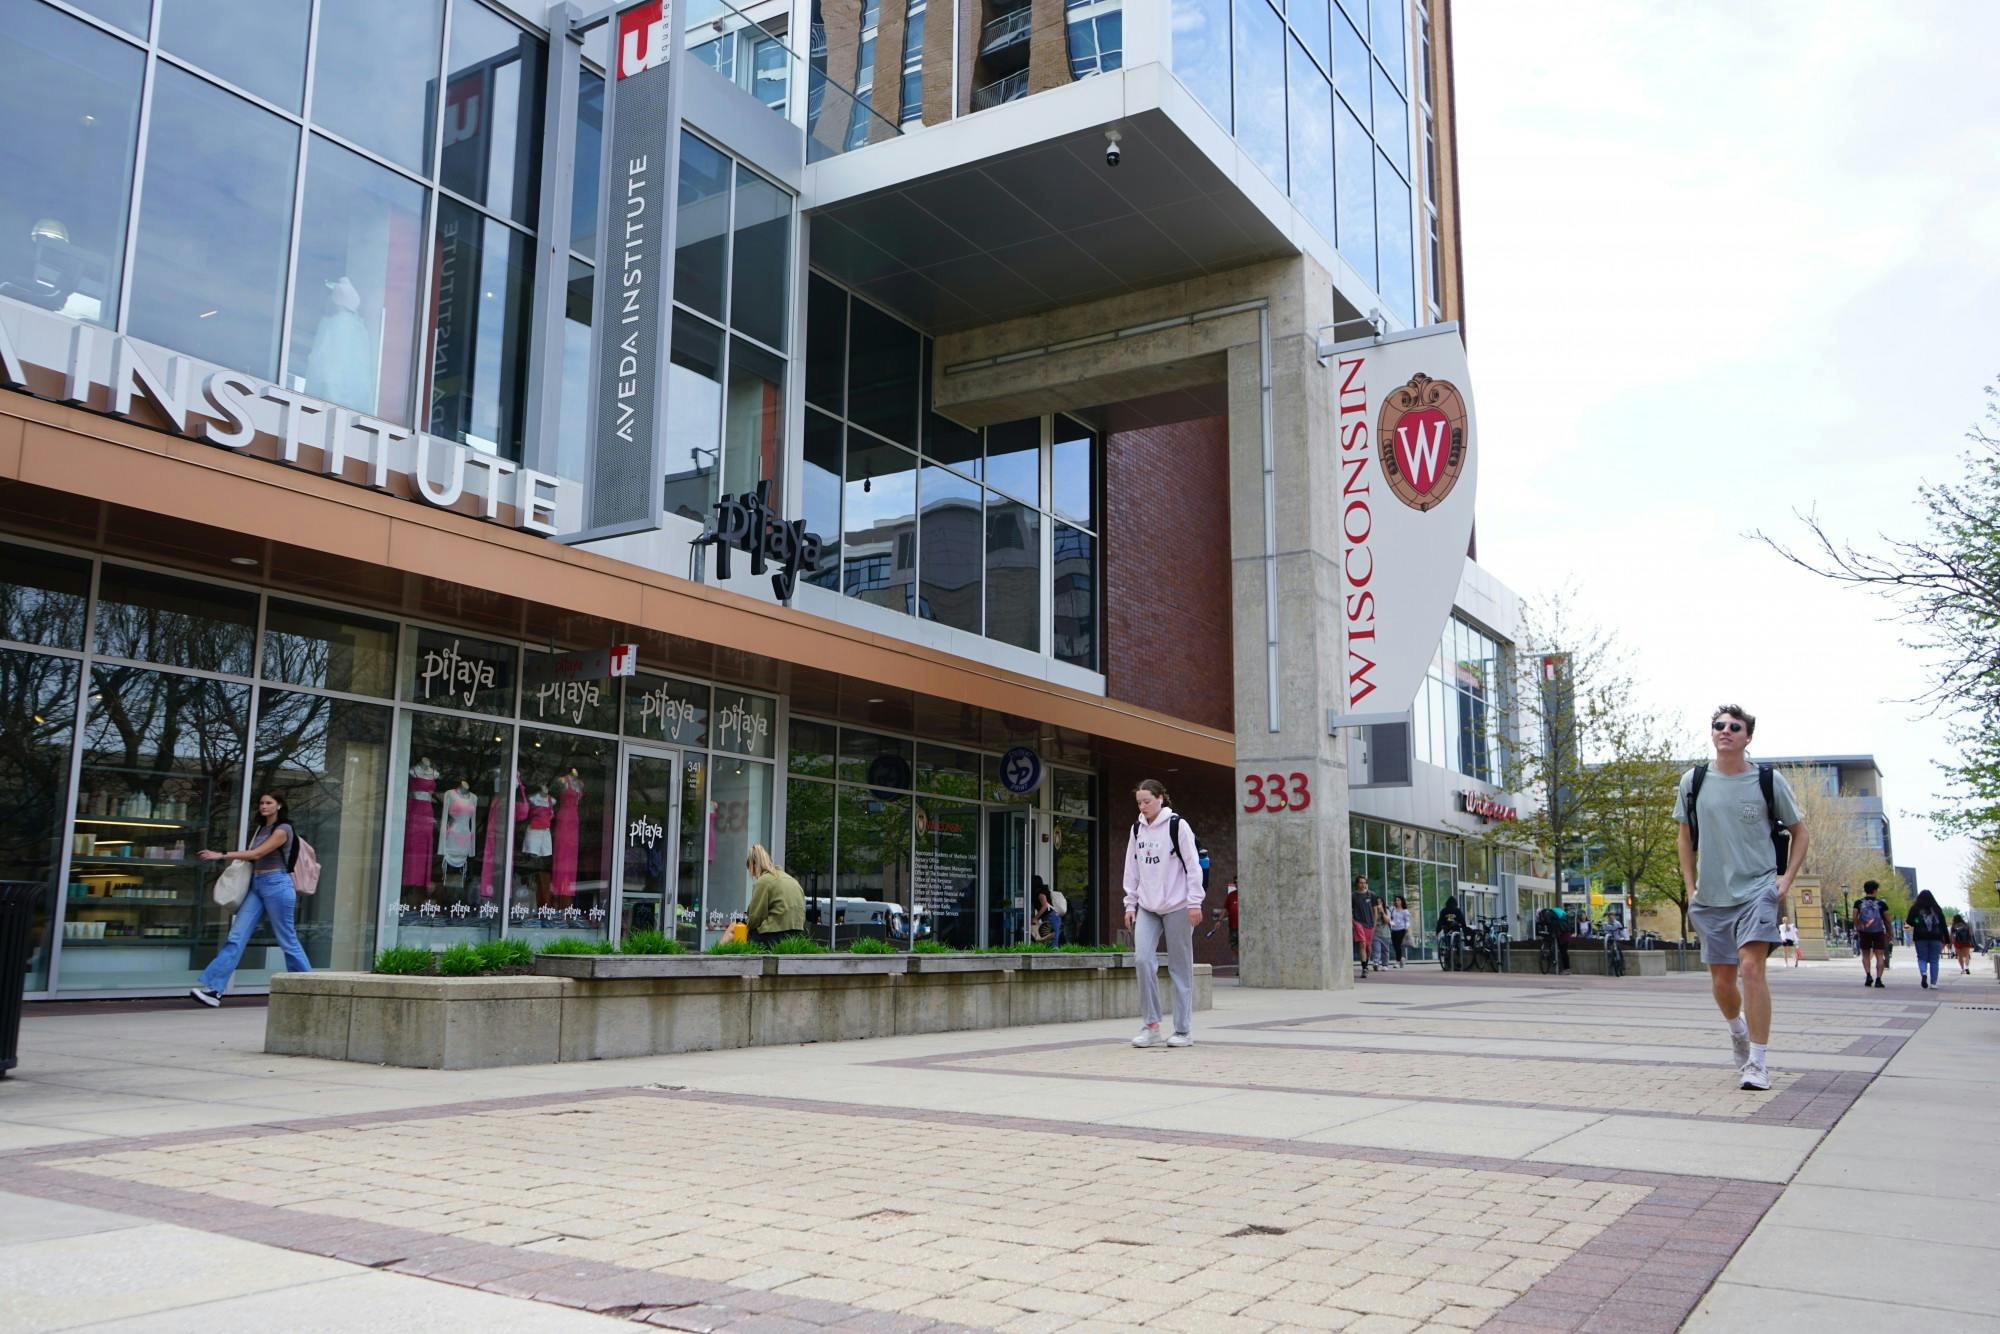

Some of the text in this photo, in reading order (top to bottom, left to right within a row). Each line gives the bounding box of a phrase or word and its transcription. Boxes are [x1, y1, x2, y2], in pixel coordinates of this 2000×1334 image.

[616, 154, 648, 443] AVEDA INSTITUTE
[64, 323, 561, 537] INSTITUTE
[1397, 419, 1446, 485] W
[713, 479, 824, 600] pitaya
[1338, 356, 1377, 710] WISCONSIN
[421, 640, 496, 706] pitaya
[639, 681, 695, 740] pitaya
[719, 697, 769, 751] pitaya
[687, 761, 701, 772] 341
[1243, 771, 1311, 813] 333
[629, 814, 663, 849] pitaya
[420, 899, 441, 918] pitaya
[450, 900, 471, 919] pitaya
[480, 901, 499, 919] pitaya
[511, 902, 606, 921] pitaya pitaya pitaya pitaya
